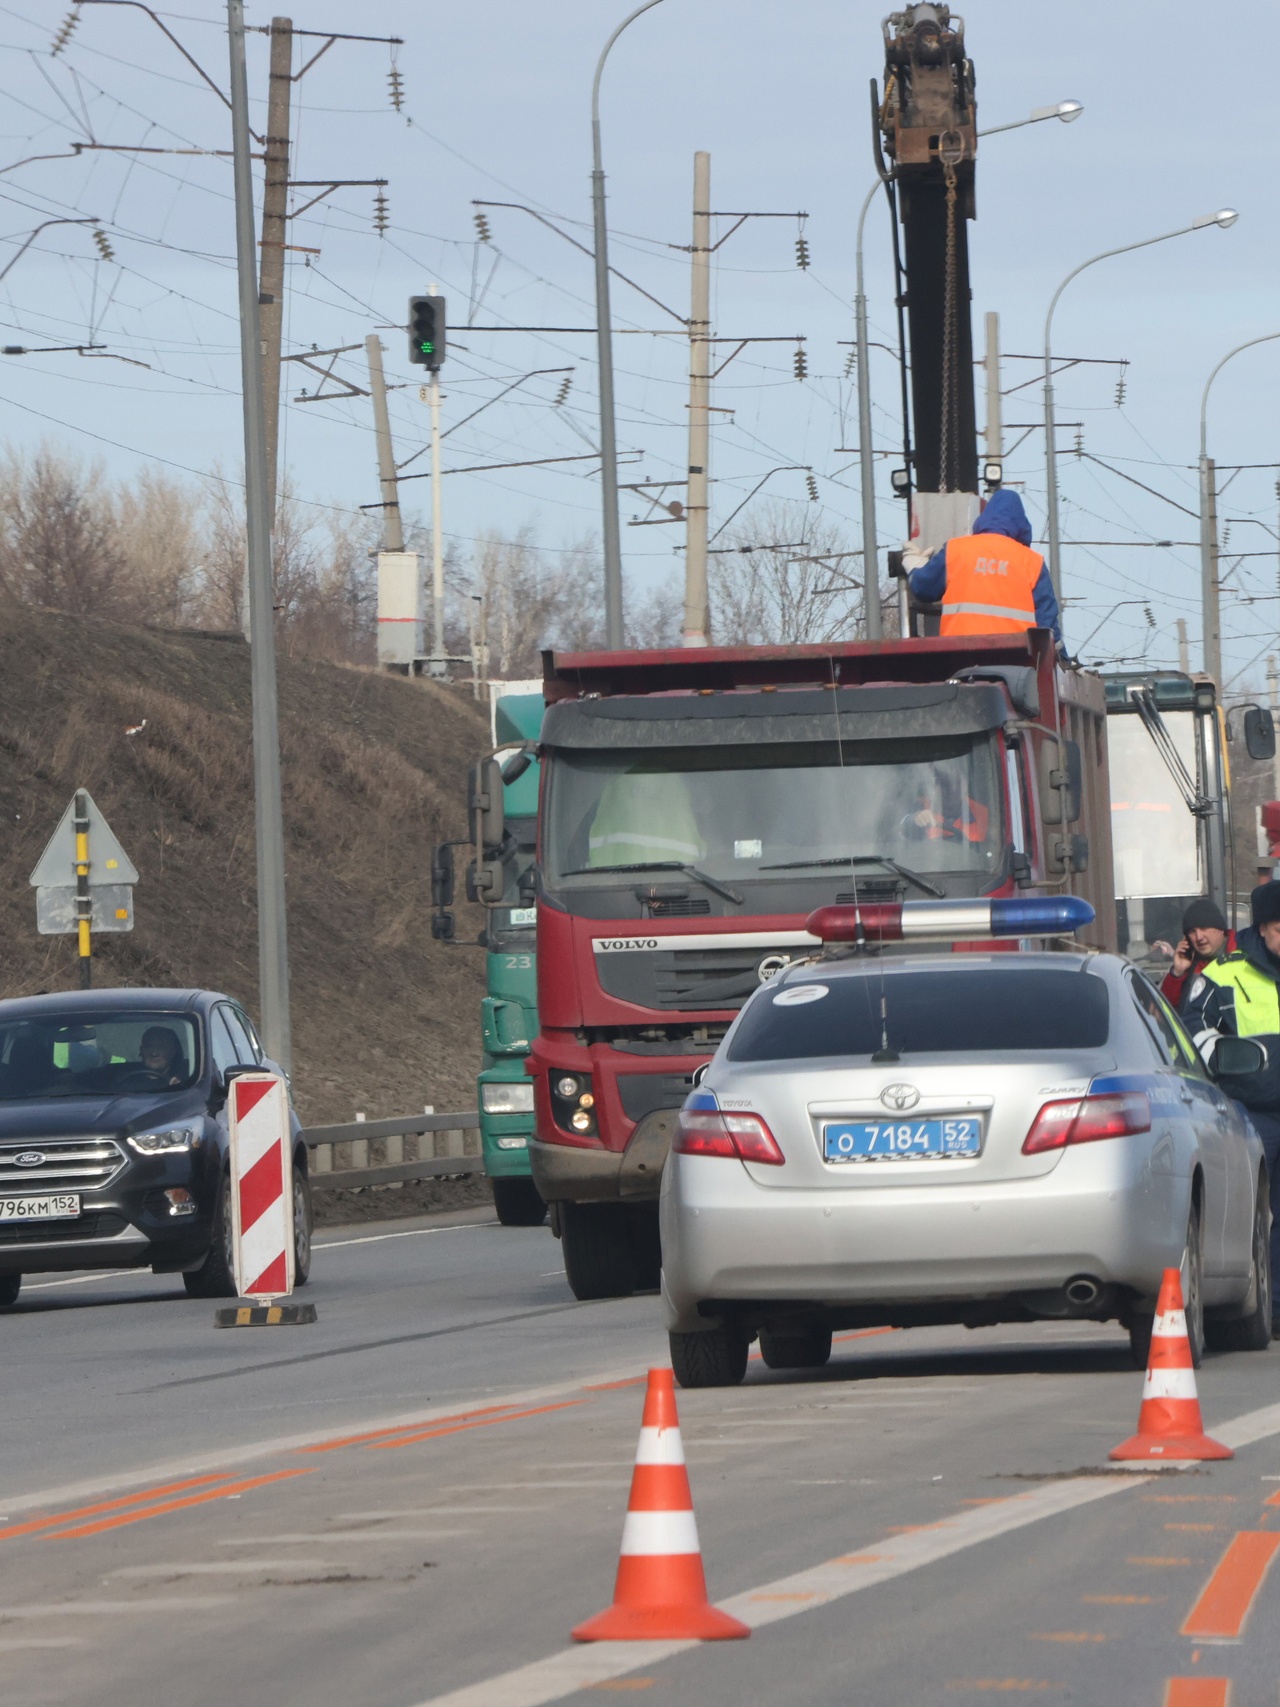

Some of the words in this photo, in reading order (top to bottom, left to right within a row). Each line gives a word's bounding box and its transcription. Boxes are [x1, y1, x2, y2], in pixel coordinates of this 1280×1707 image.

[973, 556, 1009, 577] ДСК
[598, 939, 658, 950] VOLVO
[505, 956, 532, 969] 23
[1037, 1086, 1087, 1095] CAMRY
[722, 1099, 753, 1108] TOYOTA
[864, 1124, 930, 1152] 7184
[944, 1122, 971, 1142] 52
[947, 1141, 968, 1149] RUS
[20, 1154, 39, 1163] Ford
[51, 1196, 75, 1209] 152
